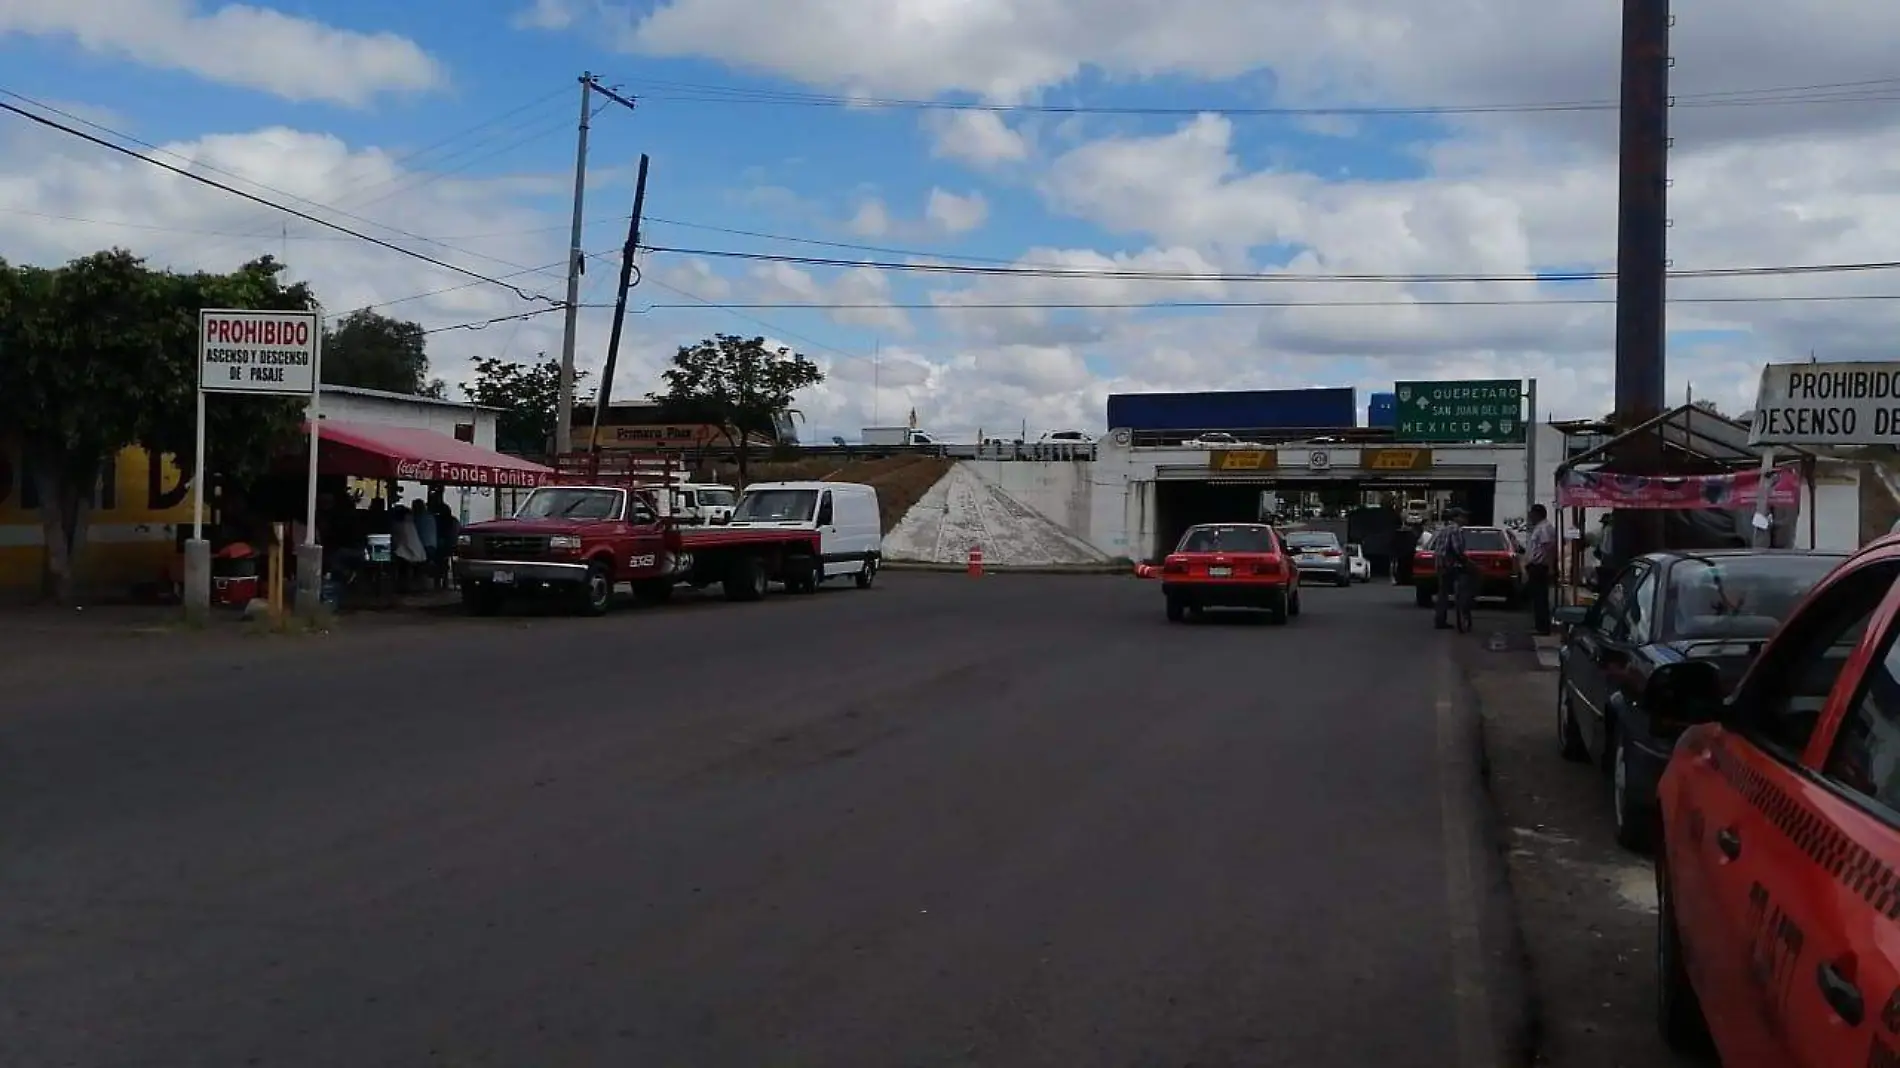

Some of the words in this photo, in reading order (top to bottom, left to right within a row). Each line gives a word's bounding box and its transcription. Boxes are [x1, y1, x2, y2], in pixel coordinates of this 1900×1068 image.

[207, 319, 308, 345] PROHIBIDO
[206, 348, 249, 363] ASCENSO
[250, 350, 257, 363] Y
[260, 350, 308, 366] DESCENSO
[230, 366, 242, 380] DE
[250, 368, 284, 382] PASAJE
[1433, 388, 1518, 399] QUERETARO
[1432, 405, 1452, 416] SAN
[1455, 405, 1479, 416] JUAN
[1481, 405, 1498, 416] DEL
[1402, 421, 1471, 433] MEXICO
[439, 462, 488, 484] Fonda
[491, 467, 535, 487] Toñita
